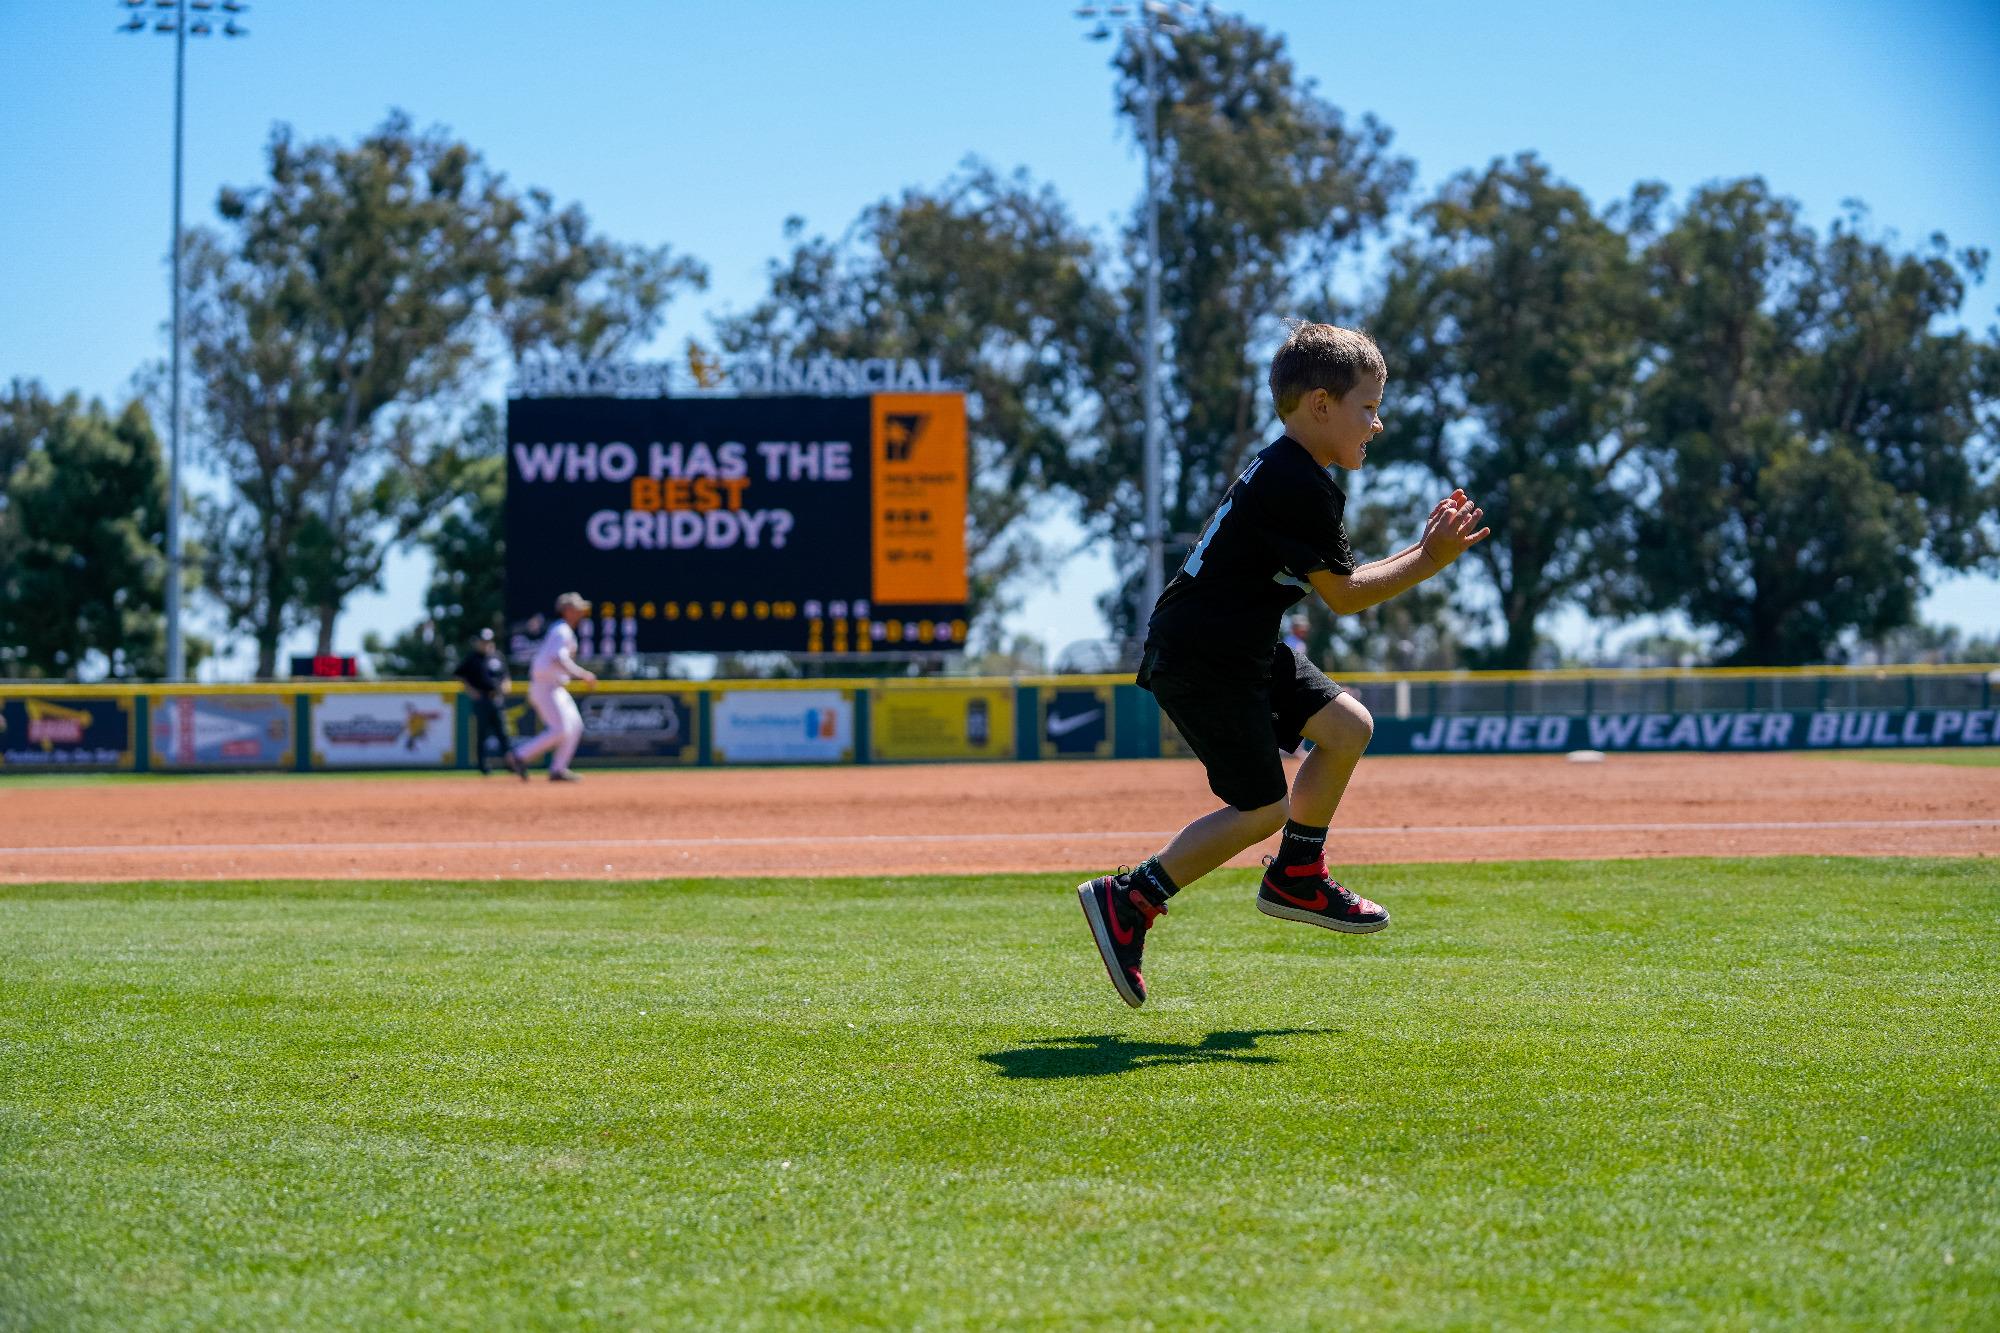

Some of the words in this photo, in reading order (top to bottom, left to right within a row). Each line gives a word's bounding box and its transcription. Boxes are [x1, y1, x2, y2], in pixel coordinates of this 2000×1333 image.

[736, 357, 951, 392] FINANCIAL
[513, 441, 638, 483] WHO
[648, 441, 748, 481] HAS
[756, 441, 852, 481] THE
[631, 475, 751, 513] BEST
[586, 508, 794, 550] GRIDDY?
[1411, 715, 1570, 750] JERED
[1588, 712, 1794, 748] WEAVER
[1807, 710, 2000, 747] BULLPE
